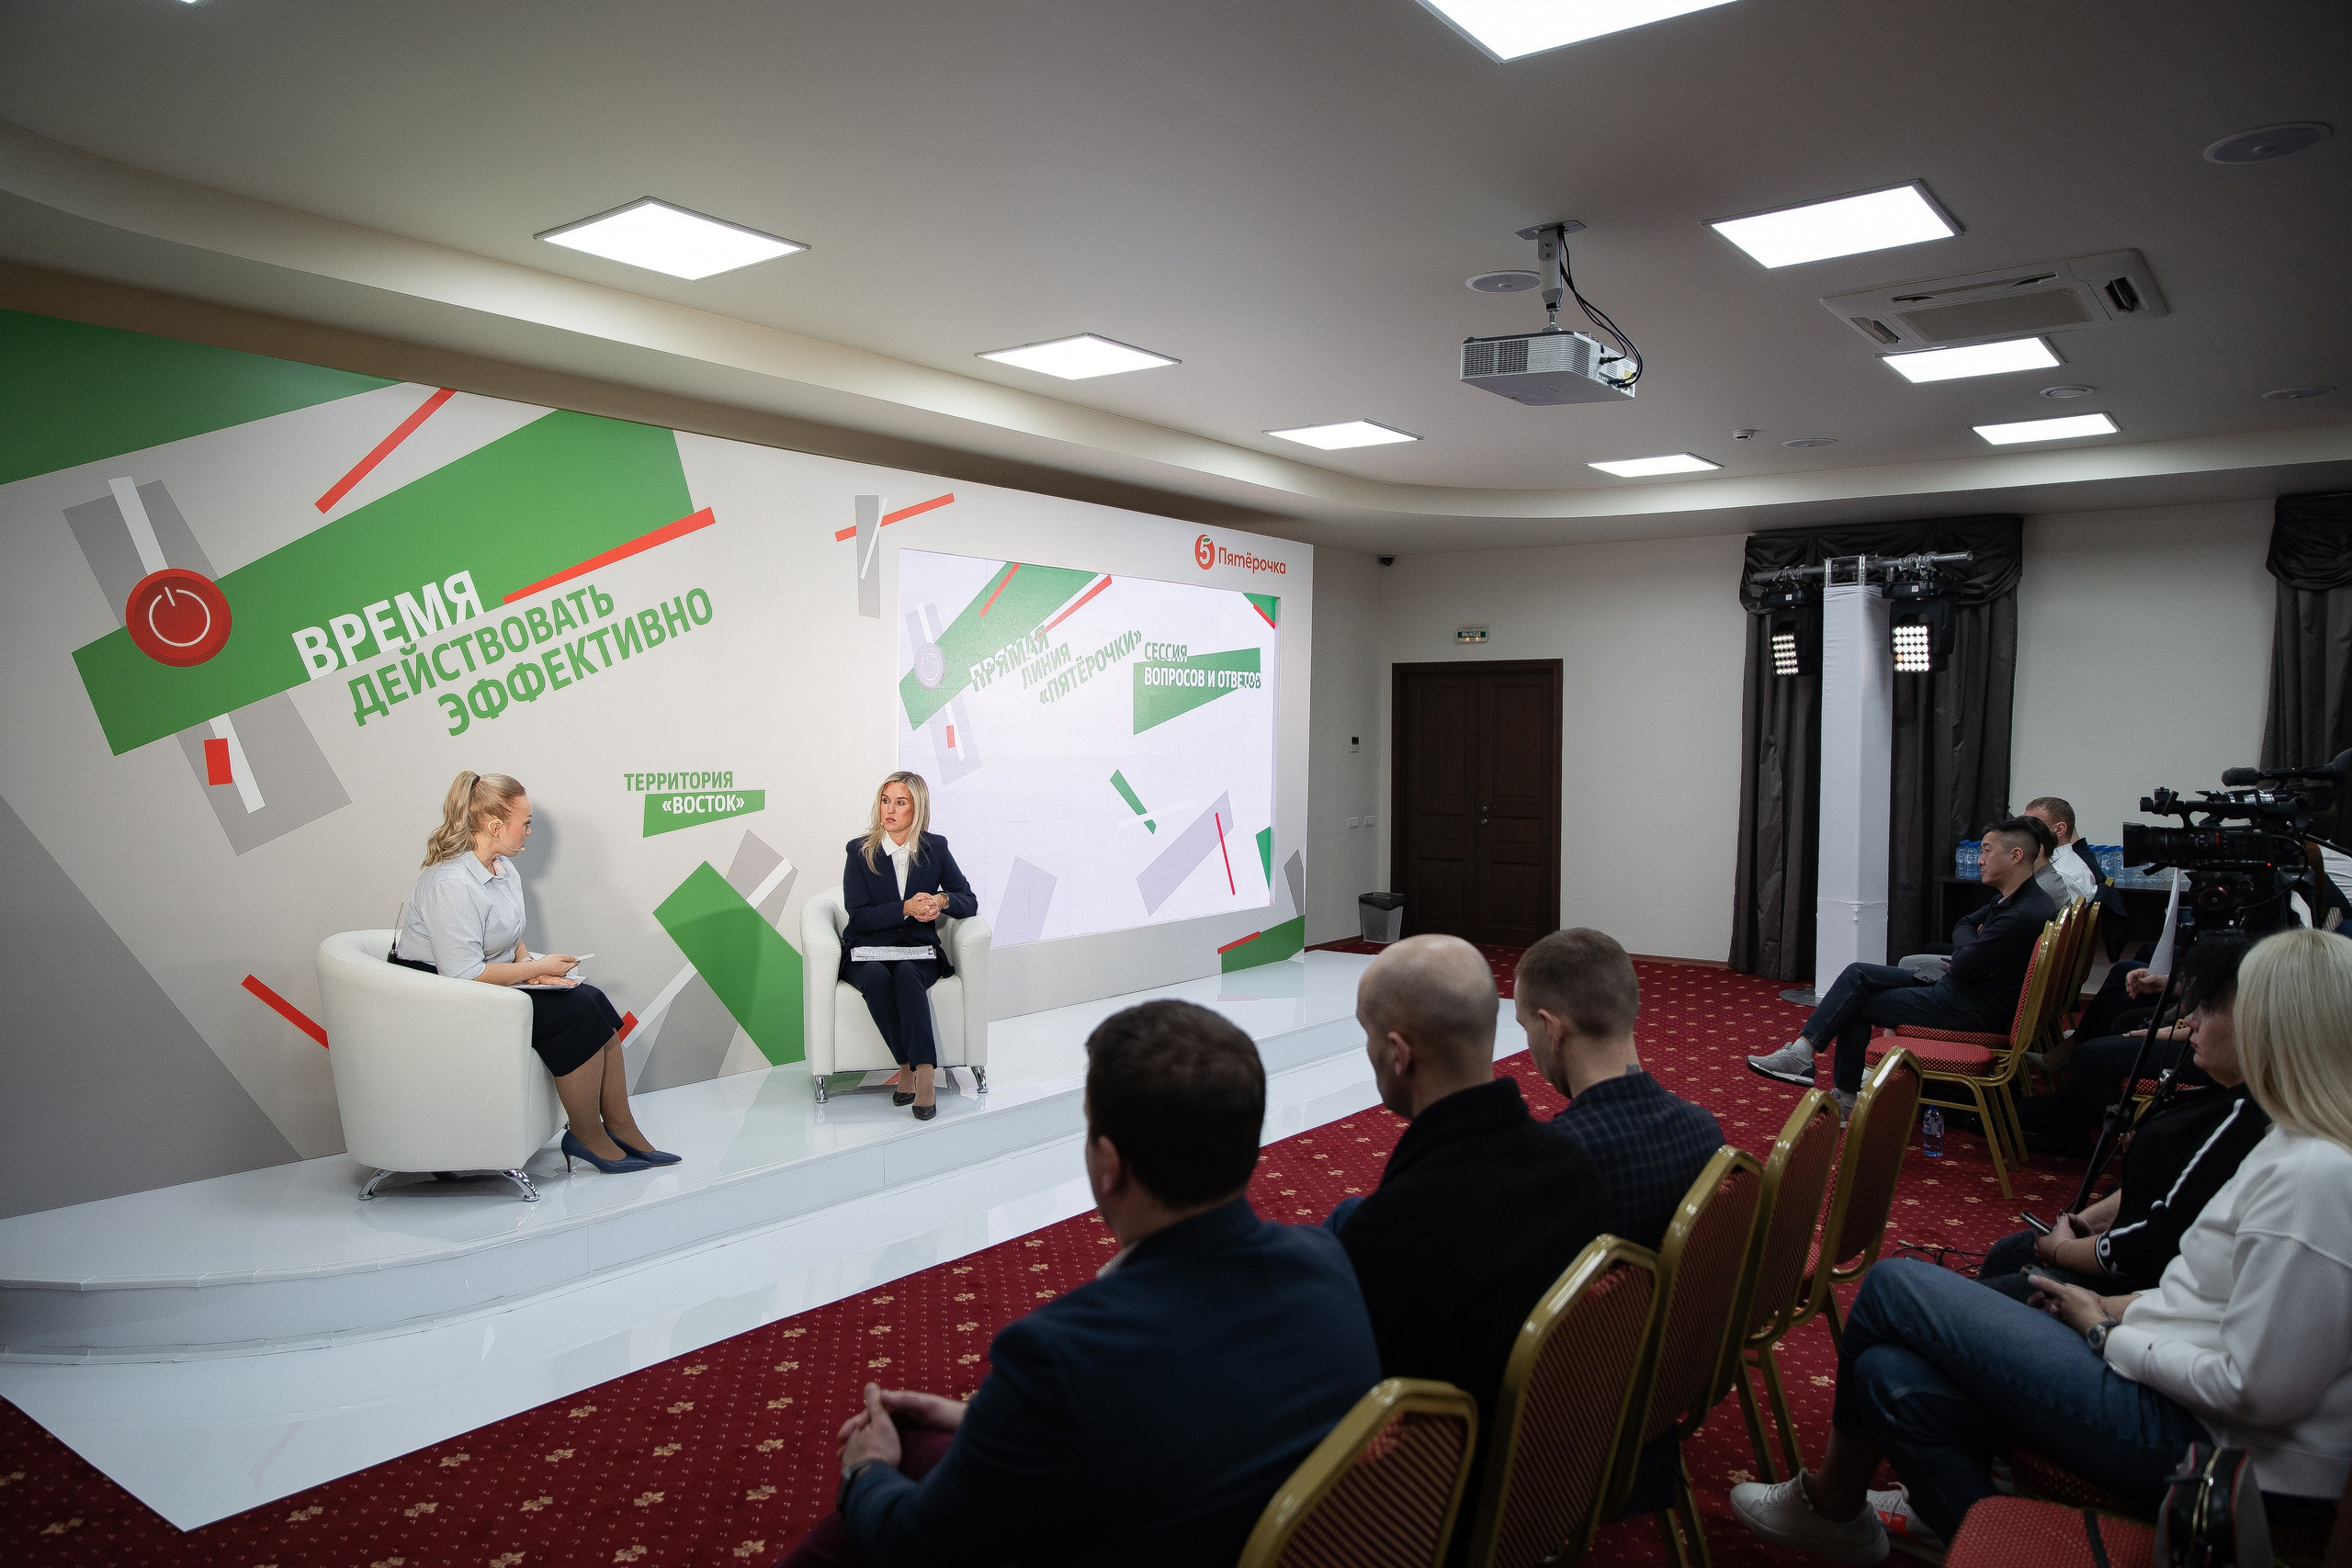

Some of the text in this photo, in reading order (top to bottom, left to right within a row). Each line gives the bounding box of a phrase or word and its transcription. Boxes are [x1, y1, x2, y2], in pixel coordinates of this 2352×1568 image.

[1218, 547, 1286, 575] Пятёрочка
[291, 570, 485, 682] ВРЕМЯ
[347, 584, 615, 728] ДЕЙСТВОВАТЬ
[437, 587, 713, 737] ЭФФЕКТИВНО
[969, 625, 1050, 693] ПРЯМАЯ
[1021, 642, 1071, 690] ЛИНИЯ
[1039, 630, 1142, 705] «ПЯТЁРОЧКИ»
[1144, 642, 1188, 662] СЕССИЯ
[1144, 666, 1261, 689] ВОПРОСОВ И ОТВЕТОВ
[624, 771, 733, 791] ТЕРРИТОРИЯ
[662, 795, 745, 815] «ВОСТОК»
